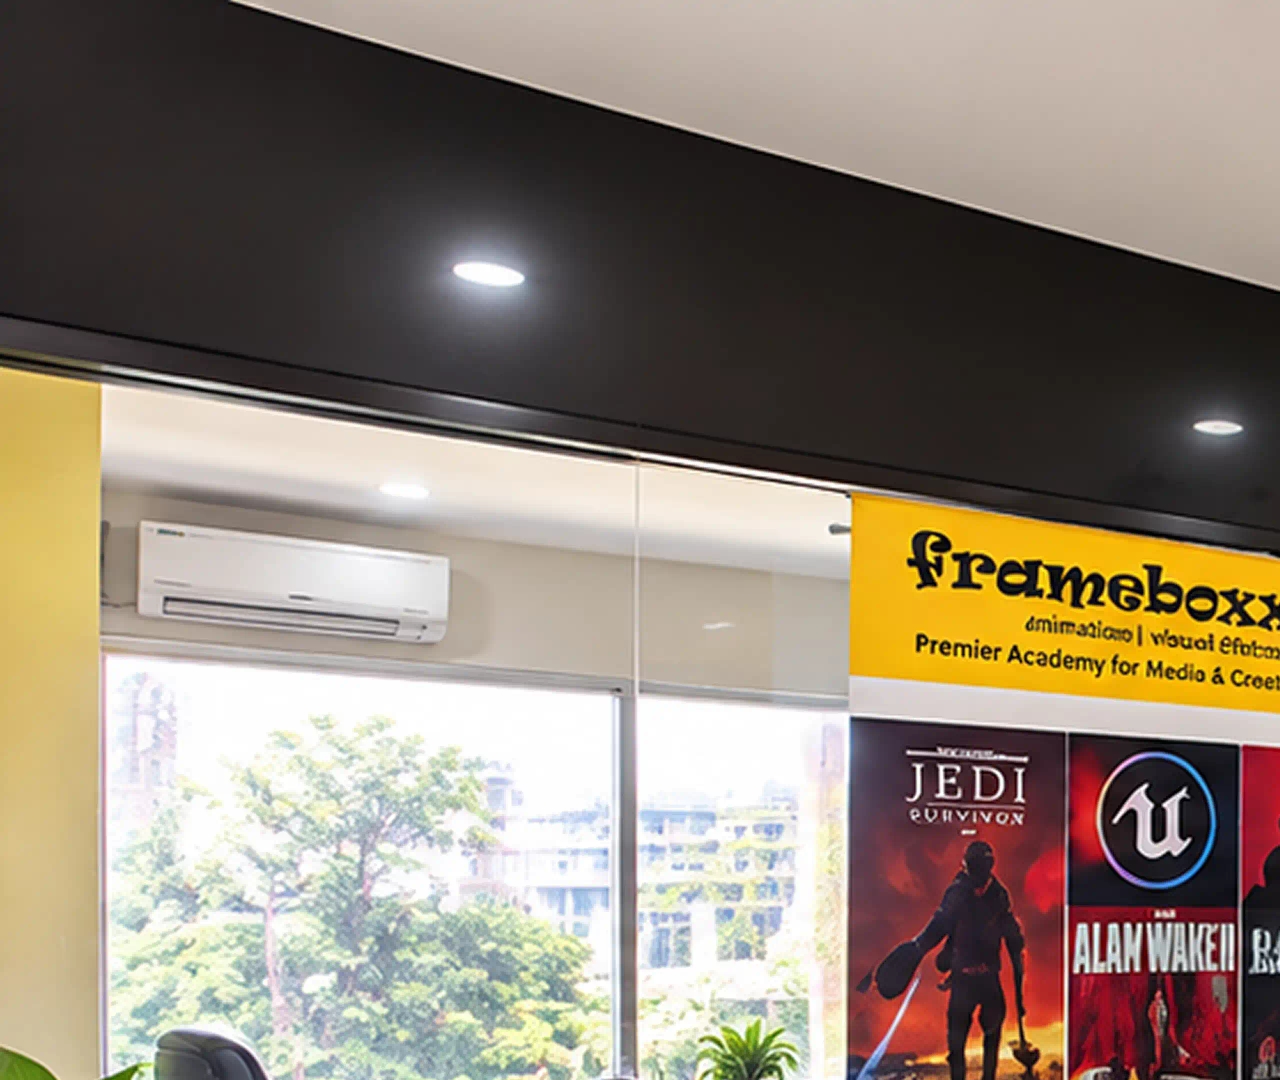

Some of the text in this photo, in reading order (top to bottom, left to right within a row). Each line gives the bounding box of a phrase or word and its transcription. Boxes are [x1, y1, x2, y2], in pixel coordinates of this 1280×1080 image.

[915, 633, 1003, 662] Premier
[1007, 644, 1105, 679] Academy
[1110, 653, 1139, 677] for
[905, 763, 1026, 803] JEDI
[1072, 922, 1144, 974] ALAN
